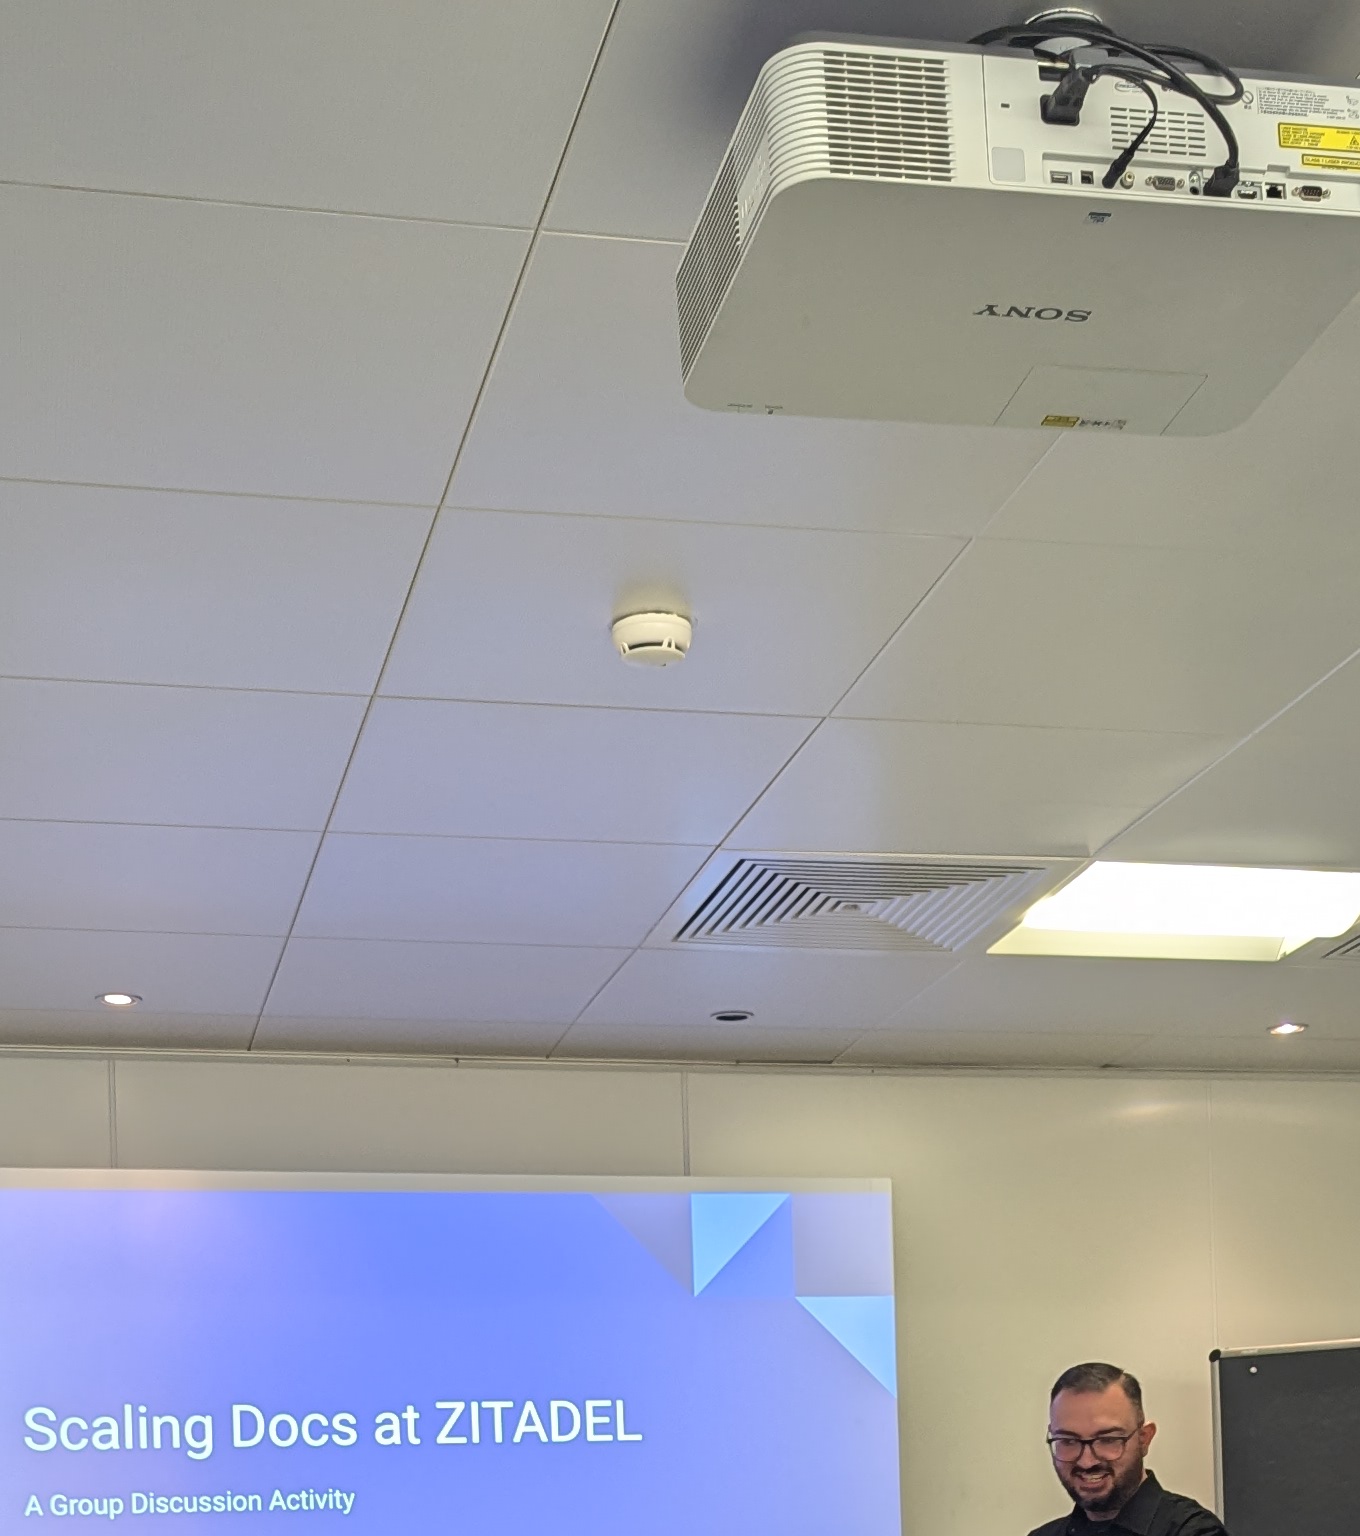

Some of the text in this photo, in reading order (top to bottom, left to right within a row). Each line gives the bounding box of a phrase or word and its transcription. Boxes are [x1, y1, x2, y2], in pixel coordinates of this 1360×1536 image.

[973, 304, 1093, 323] SONY
[24, 1400, 642, 1459] Scaling Docs at ZITADEL
[25, 1489, 355, 1519] A Group Discussion Activity
